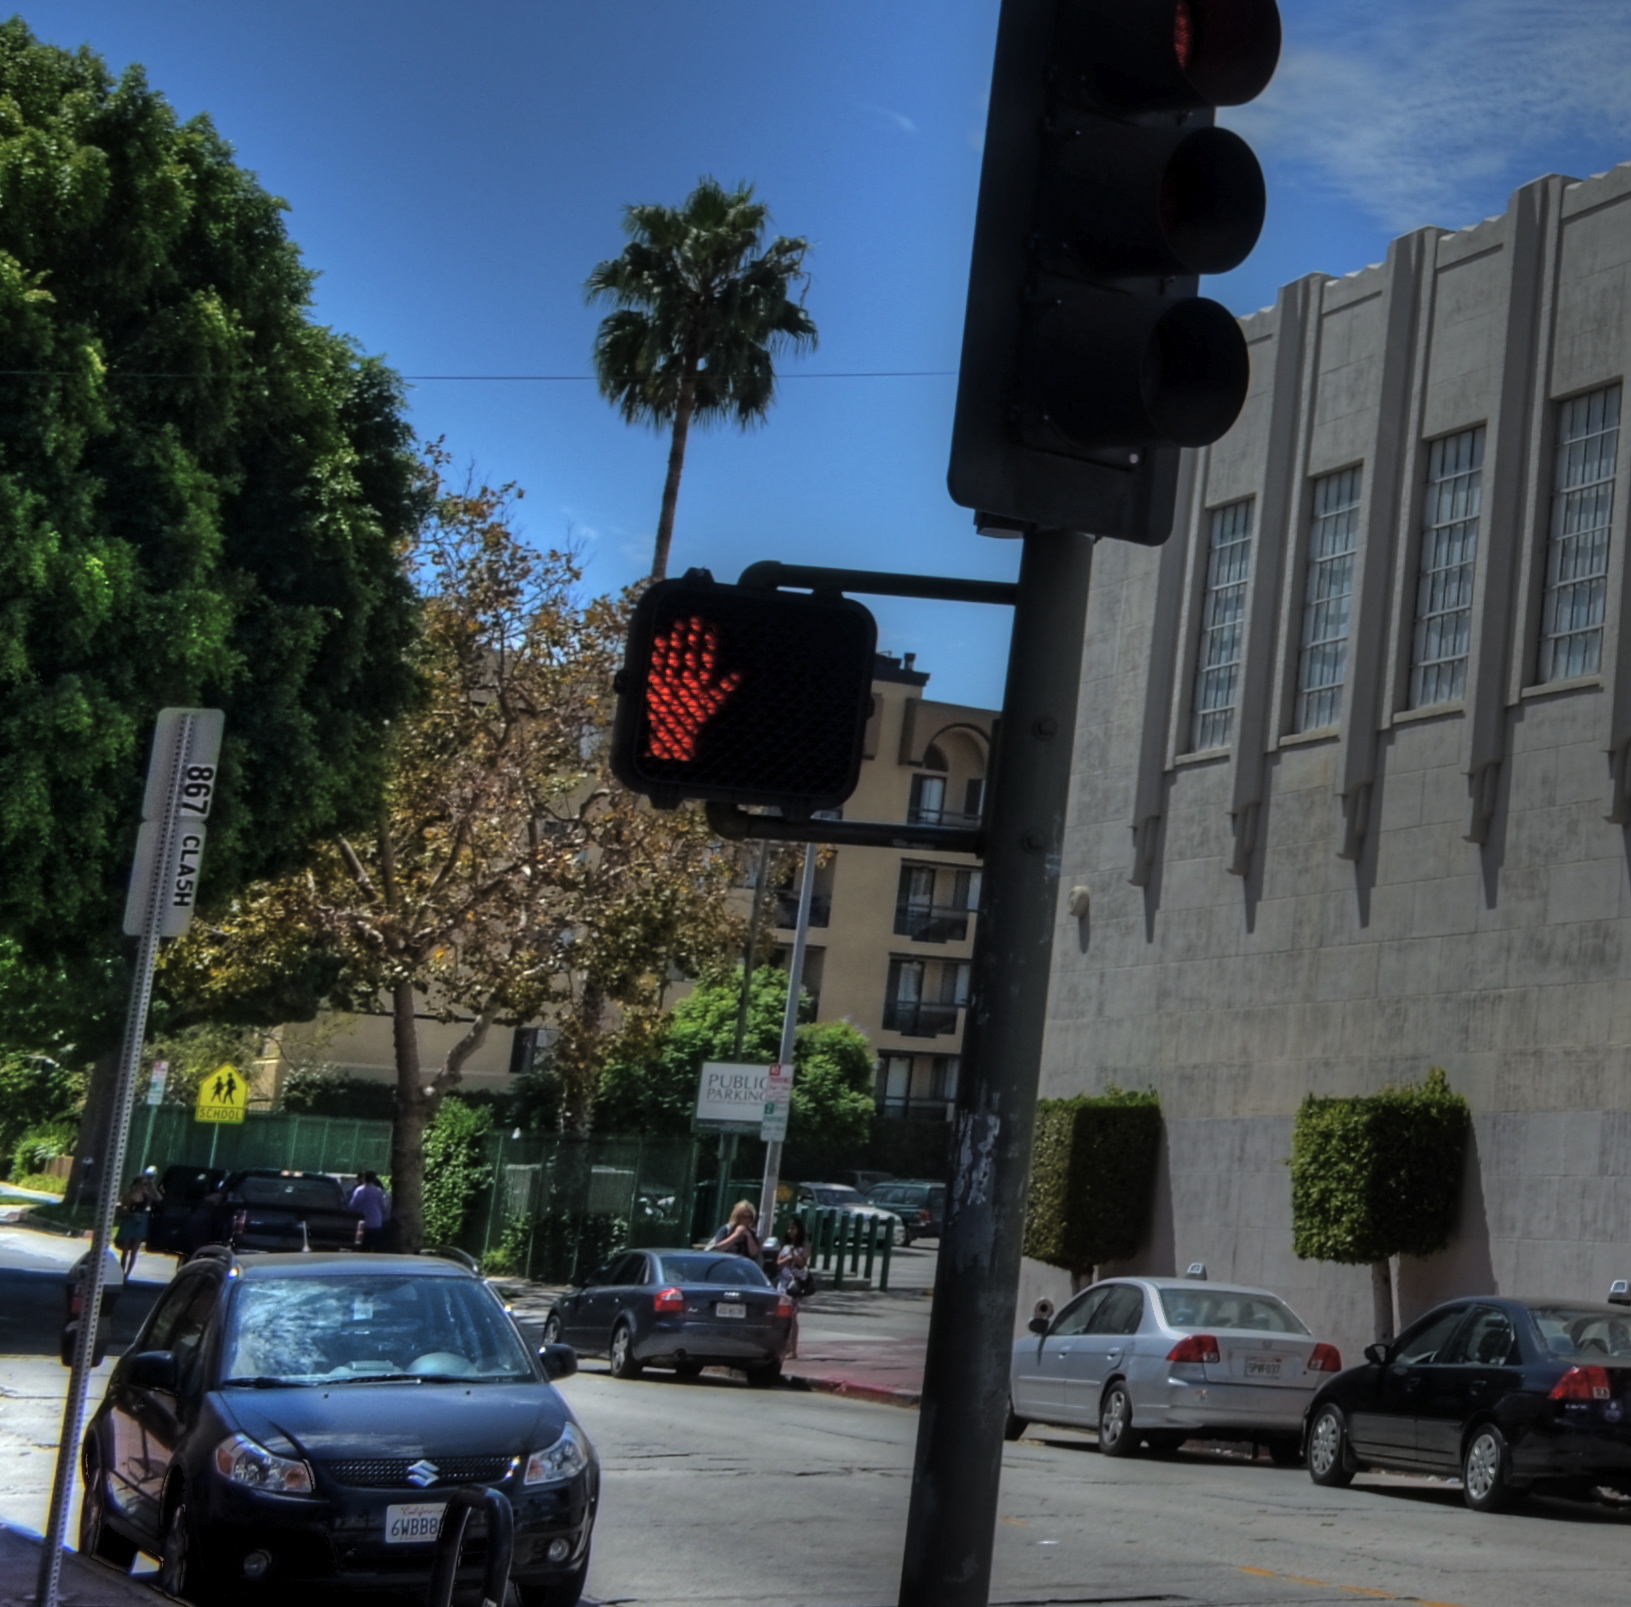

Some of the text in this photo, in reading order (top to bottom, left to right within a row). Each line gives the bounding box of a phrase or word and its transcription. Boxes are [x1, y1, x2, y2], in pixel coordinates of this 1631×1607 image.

[182, 766, 214, 816] 867
[200, 1108, 240, 1120] SCHOOL
[391, 1518, 438, 1537] 6WBB8
